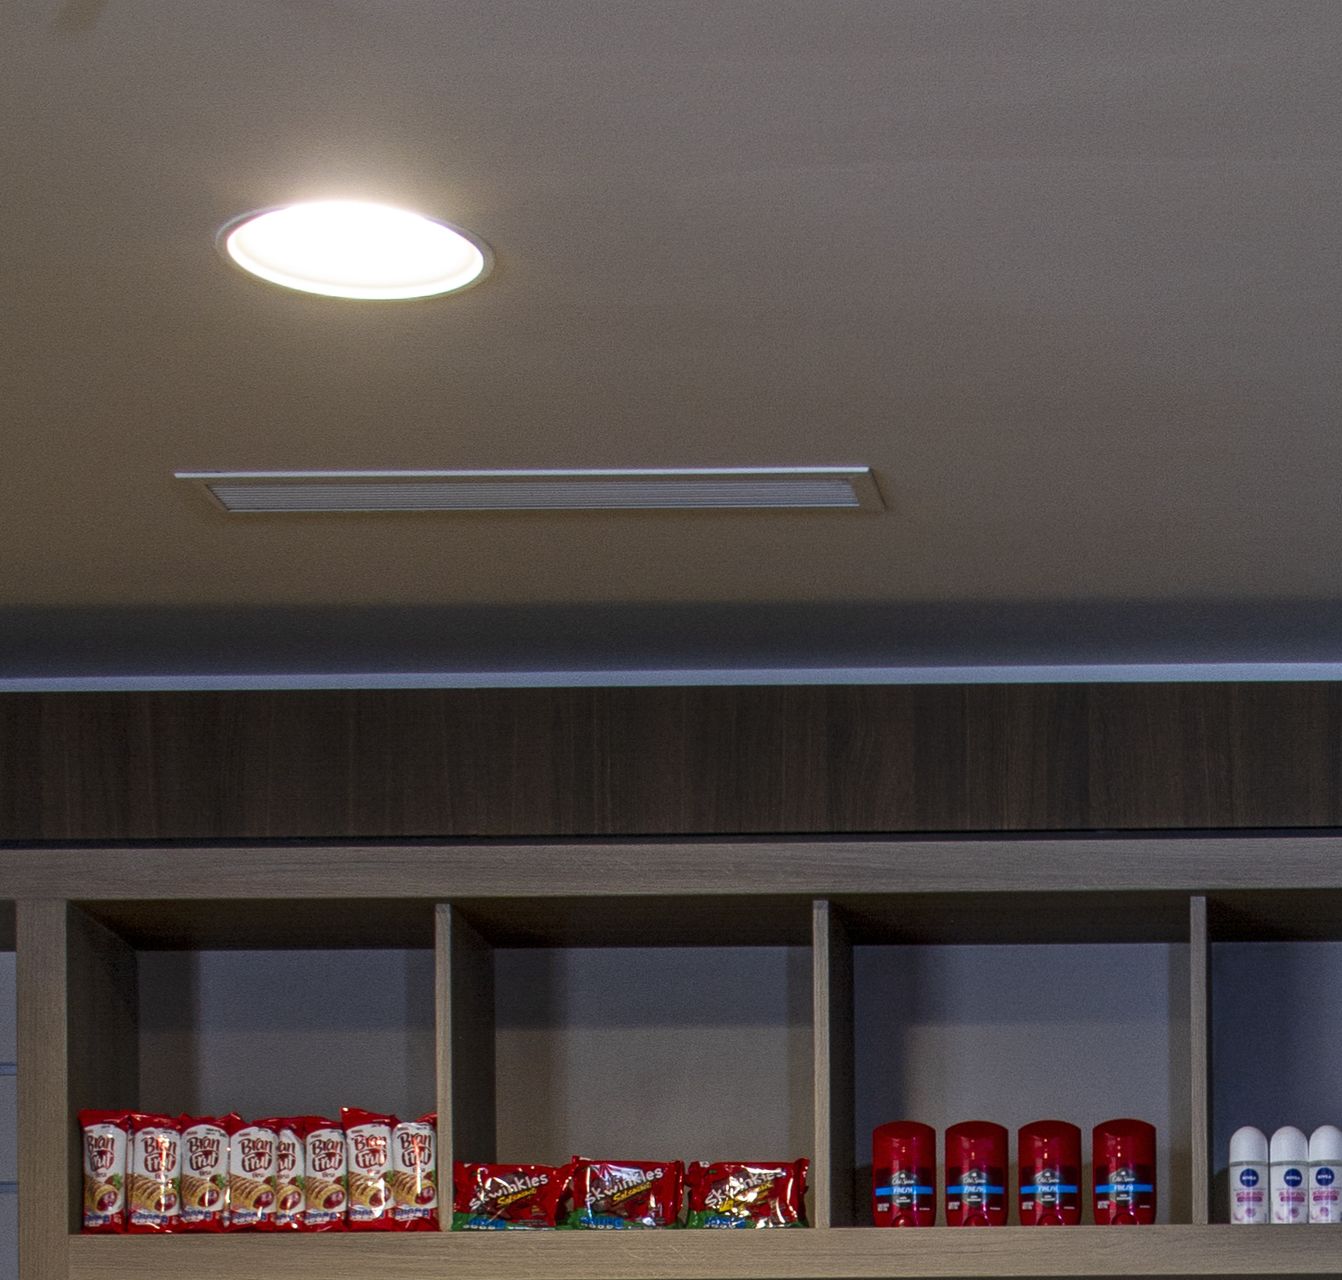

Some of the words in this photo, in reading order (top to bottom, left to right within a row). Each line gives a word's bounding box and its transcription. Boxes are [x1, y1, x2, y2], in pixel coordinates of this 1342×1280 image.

[86, 1135, 115, 1151] Bran
[187, 1135, 220, 1150] Bran
[239, 1137, 273, 1151] Bran
[310, 1138, 344, 1152] Bran
[190, 1152, 220, 1170] Frut
[243, 1153, 273, 1171] Frut
[313, 1153, 343, 1171] Frut
[469, 1173, 549, 1211] Skwinkles
[585, 1167, 664, 1206] Skwinkles
